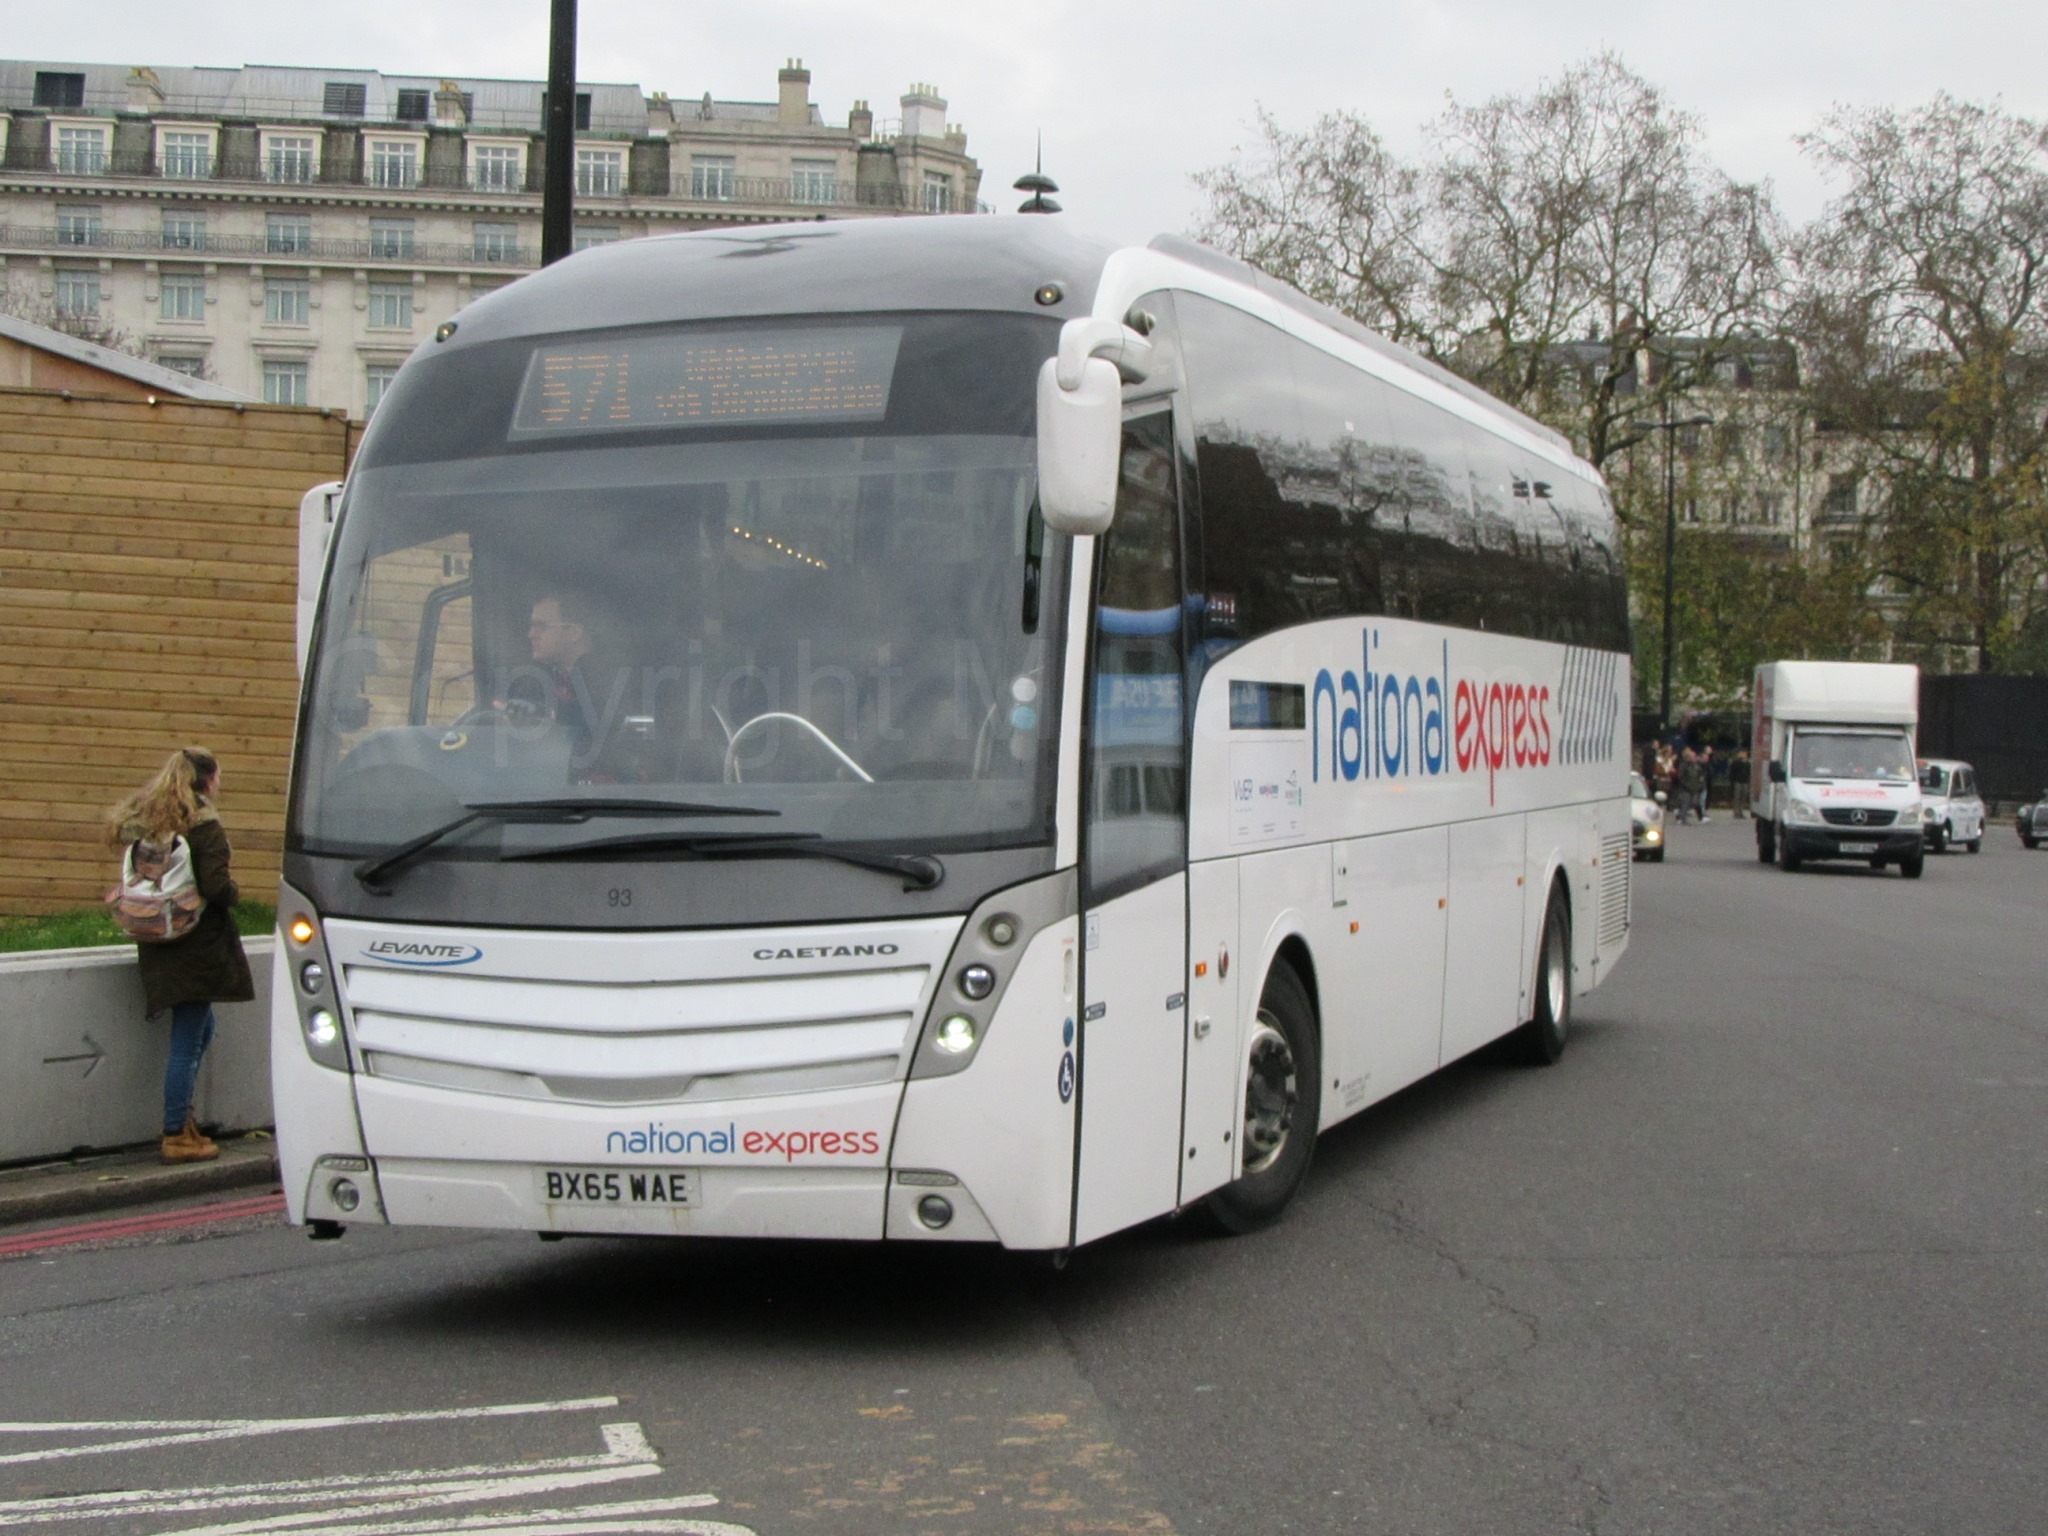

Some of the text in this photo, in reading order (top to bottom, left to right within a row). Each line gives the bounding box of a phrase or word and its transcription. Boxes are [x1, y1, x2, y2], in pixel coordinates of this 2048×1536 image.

[541, 353, 631, 421] 571
[1312, 627, 1449, 784] national
[1454, 679, 1551, 808] express
[607, 888, 632, 907] 93
[368, 940, 464, 959] LEVANTE
[752, 943, 899, 961] CAETANO
[606, 1122, 880, 1163] national express
[546, 1171, 688, 1203] BX65 WAE
